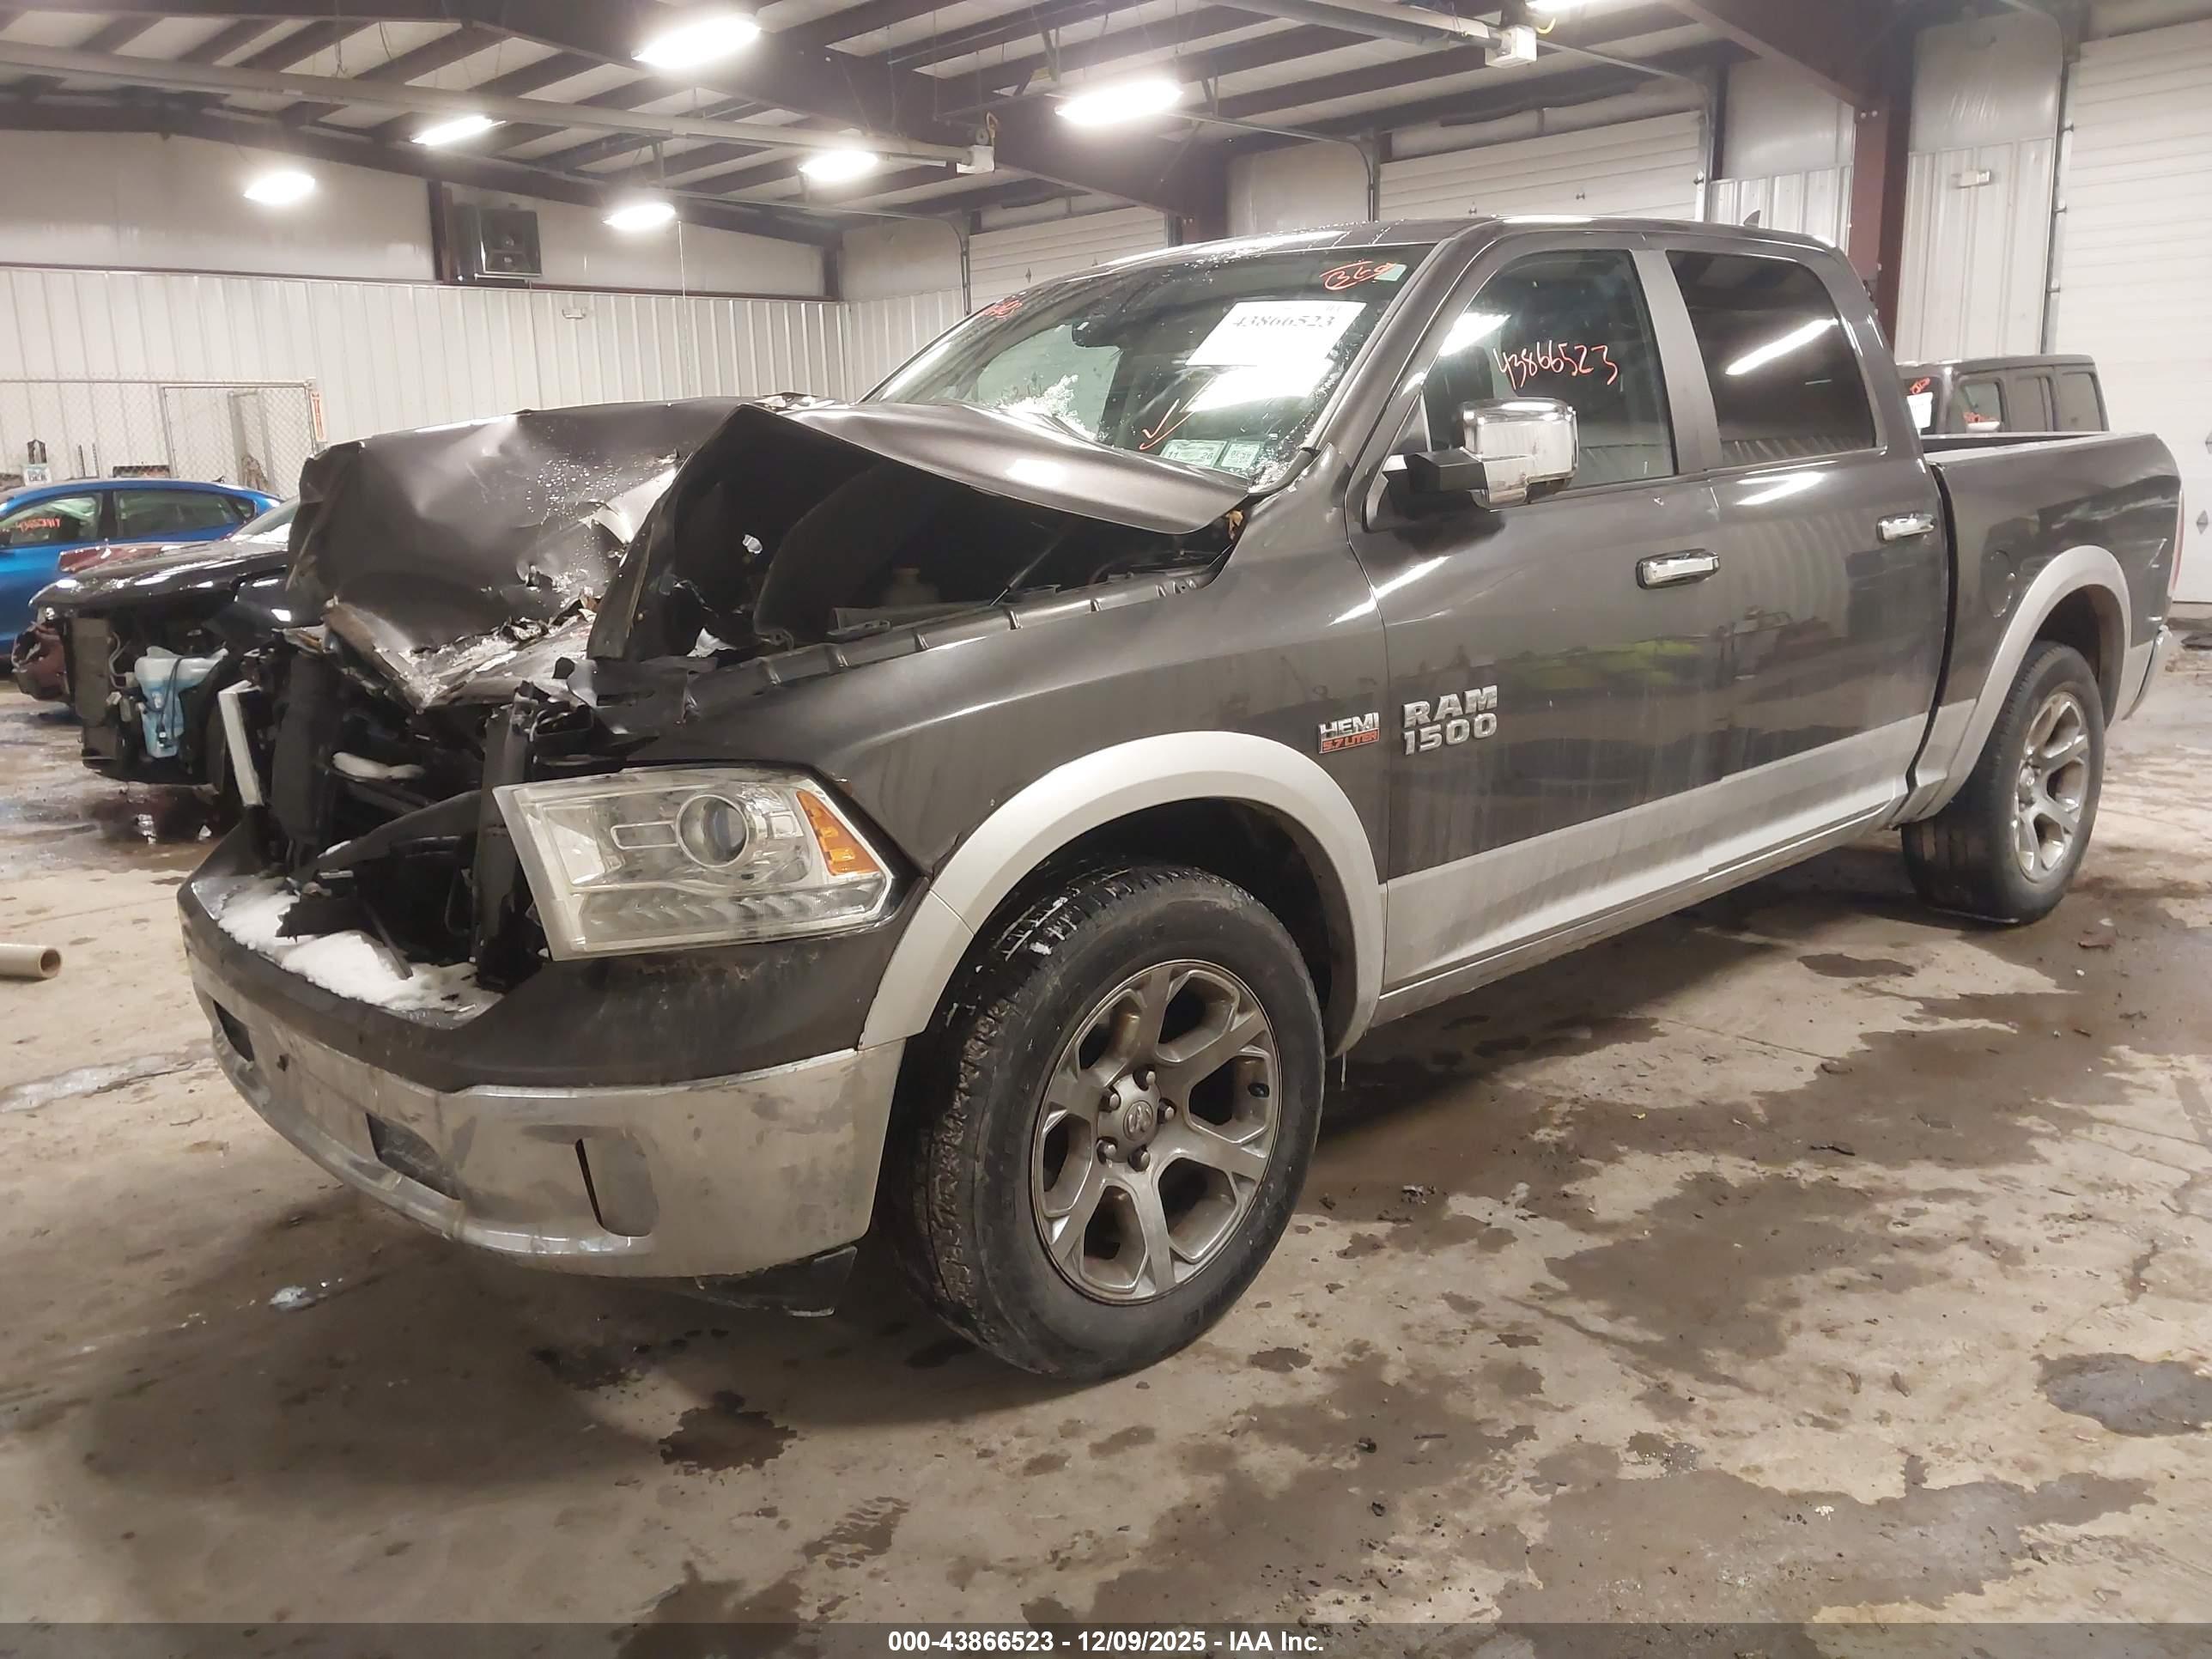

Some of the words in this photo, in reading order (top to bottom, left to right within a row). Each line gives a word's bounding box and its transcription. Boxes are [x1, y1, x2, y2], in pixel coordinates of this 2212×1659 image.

[1493, 340, 1618, 390] 43866523
[1319, 712, 1380, 739] HEMI
[1401, 685, 1498, 728] RAM
[1322, 738, 1344, 751] 5.7
[1345, 729, 1378, 746] LITER
[1401, 713, 1498, 757] 1500
